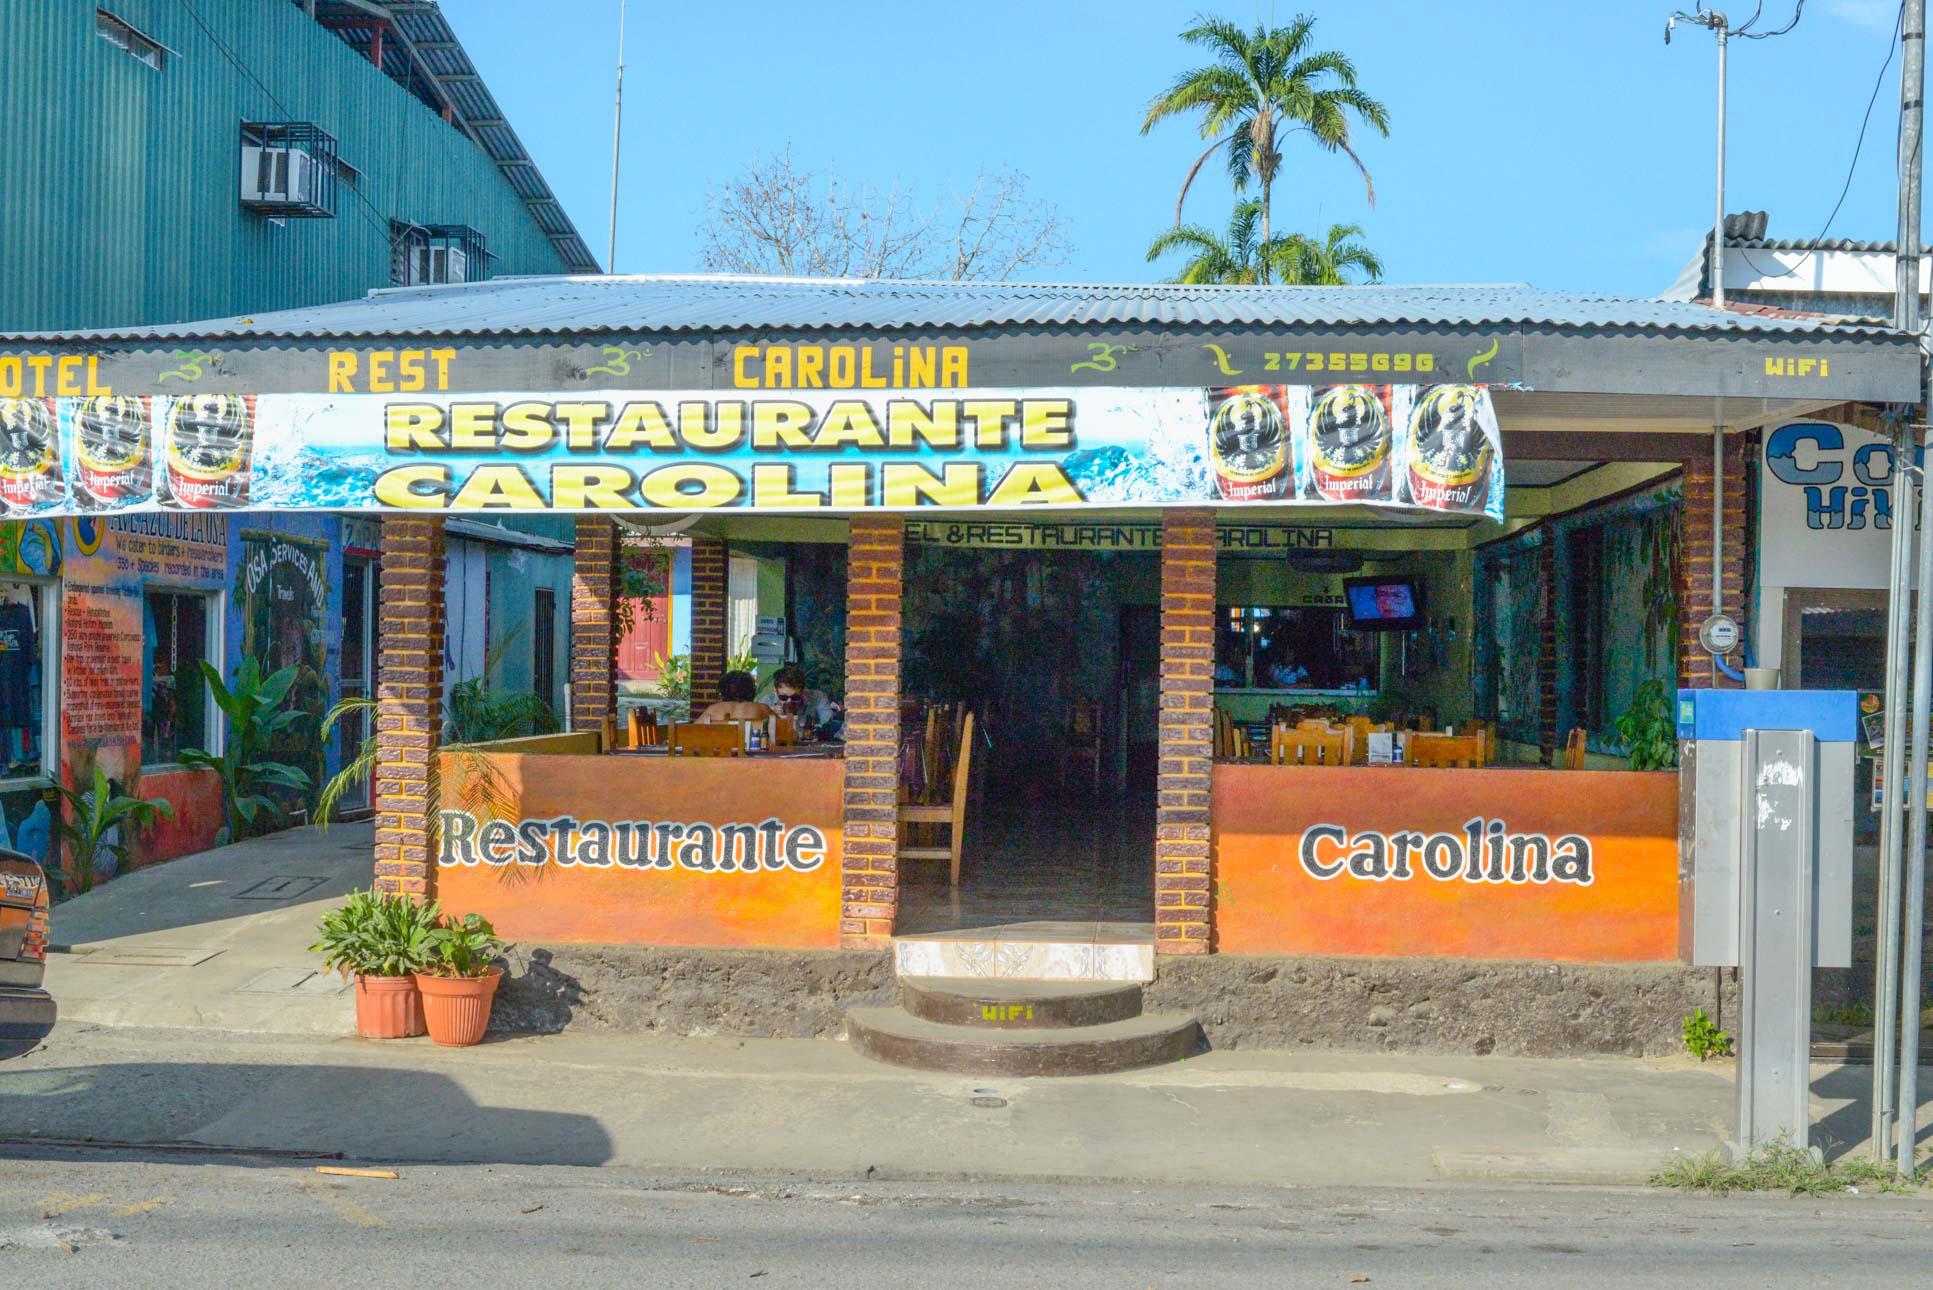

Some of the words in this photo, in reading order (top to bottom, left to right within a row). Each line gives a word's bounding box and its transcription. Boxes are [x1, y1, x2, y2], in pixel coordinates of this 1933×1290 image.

[0, 355, 112, 397] OTEL
[328, 348, 456, 393] REST
[1264, 352, 1434, 371] 27355696
[1765, 357, 1829, 377] WiFi
[384, 400, 1076, 454] RESTAURANTE
[90, 470, 134, 493] Imperial
[178, 475, 230, 500] Imperial
[371, 461, 1089, 508] CAROLINA
[1228, 478, 1276, 500] Imperial
[1325, 474, 1373, 500] Imperial
[1418, 480, 1473, 508] Imperial
[1216, 528, 1333, 547] AROLINA
[246, 549, 268, 593] OSA
[436, 808, 828, 874] Restaurante
[1298, 816, 1595, 887] Carolina
